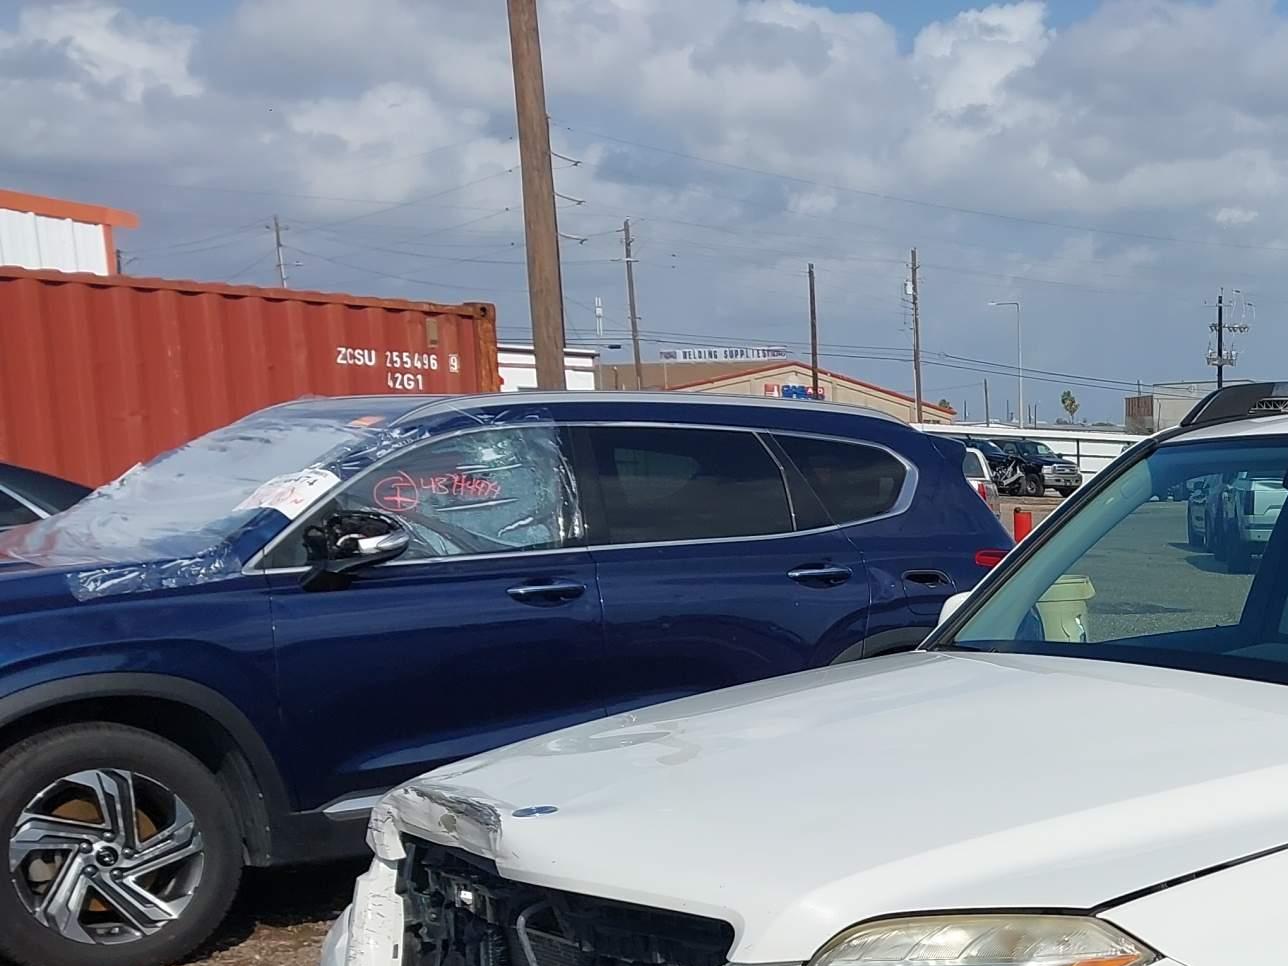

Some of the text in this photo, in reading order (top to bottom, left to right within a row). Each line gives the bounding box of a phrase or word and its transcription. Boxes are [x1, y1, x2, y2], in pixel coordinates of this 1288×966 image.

[337, 347, 459, 371] ZCSU 255496 9
[682, 350, 718, 360] WELDING
[724, 348, 767, 359] SUPPLIES
[387, 371, 423, 390] 42G1
